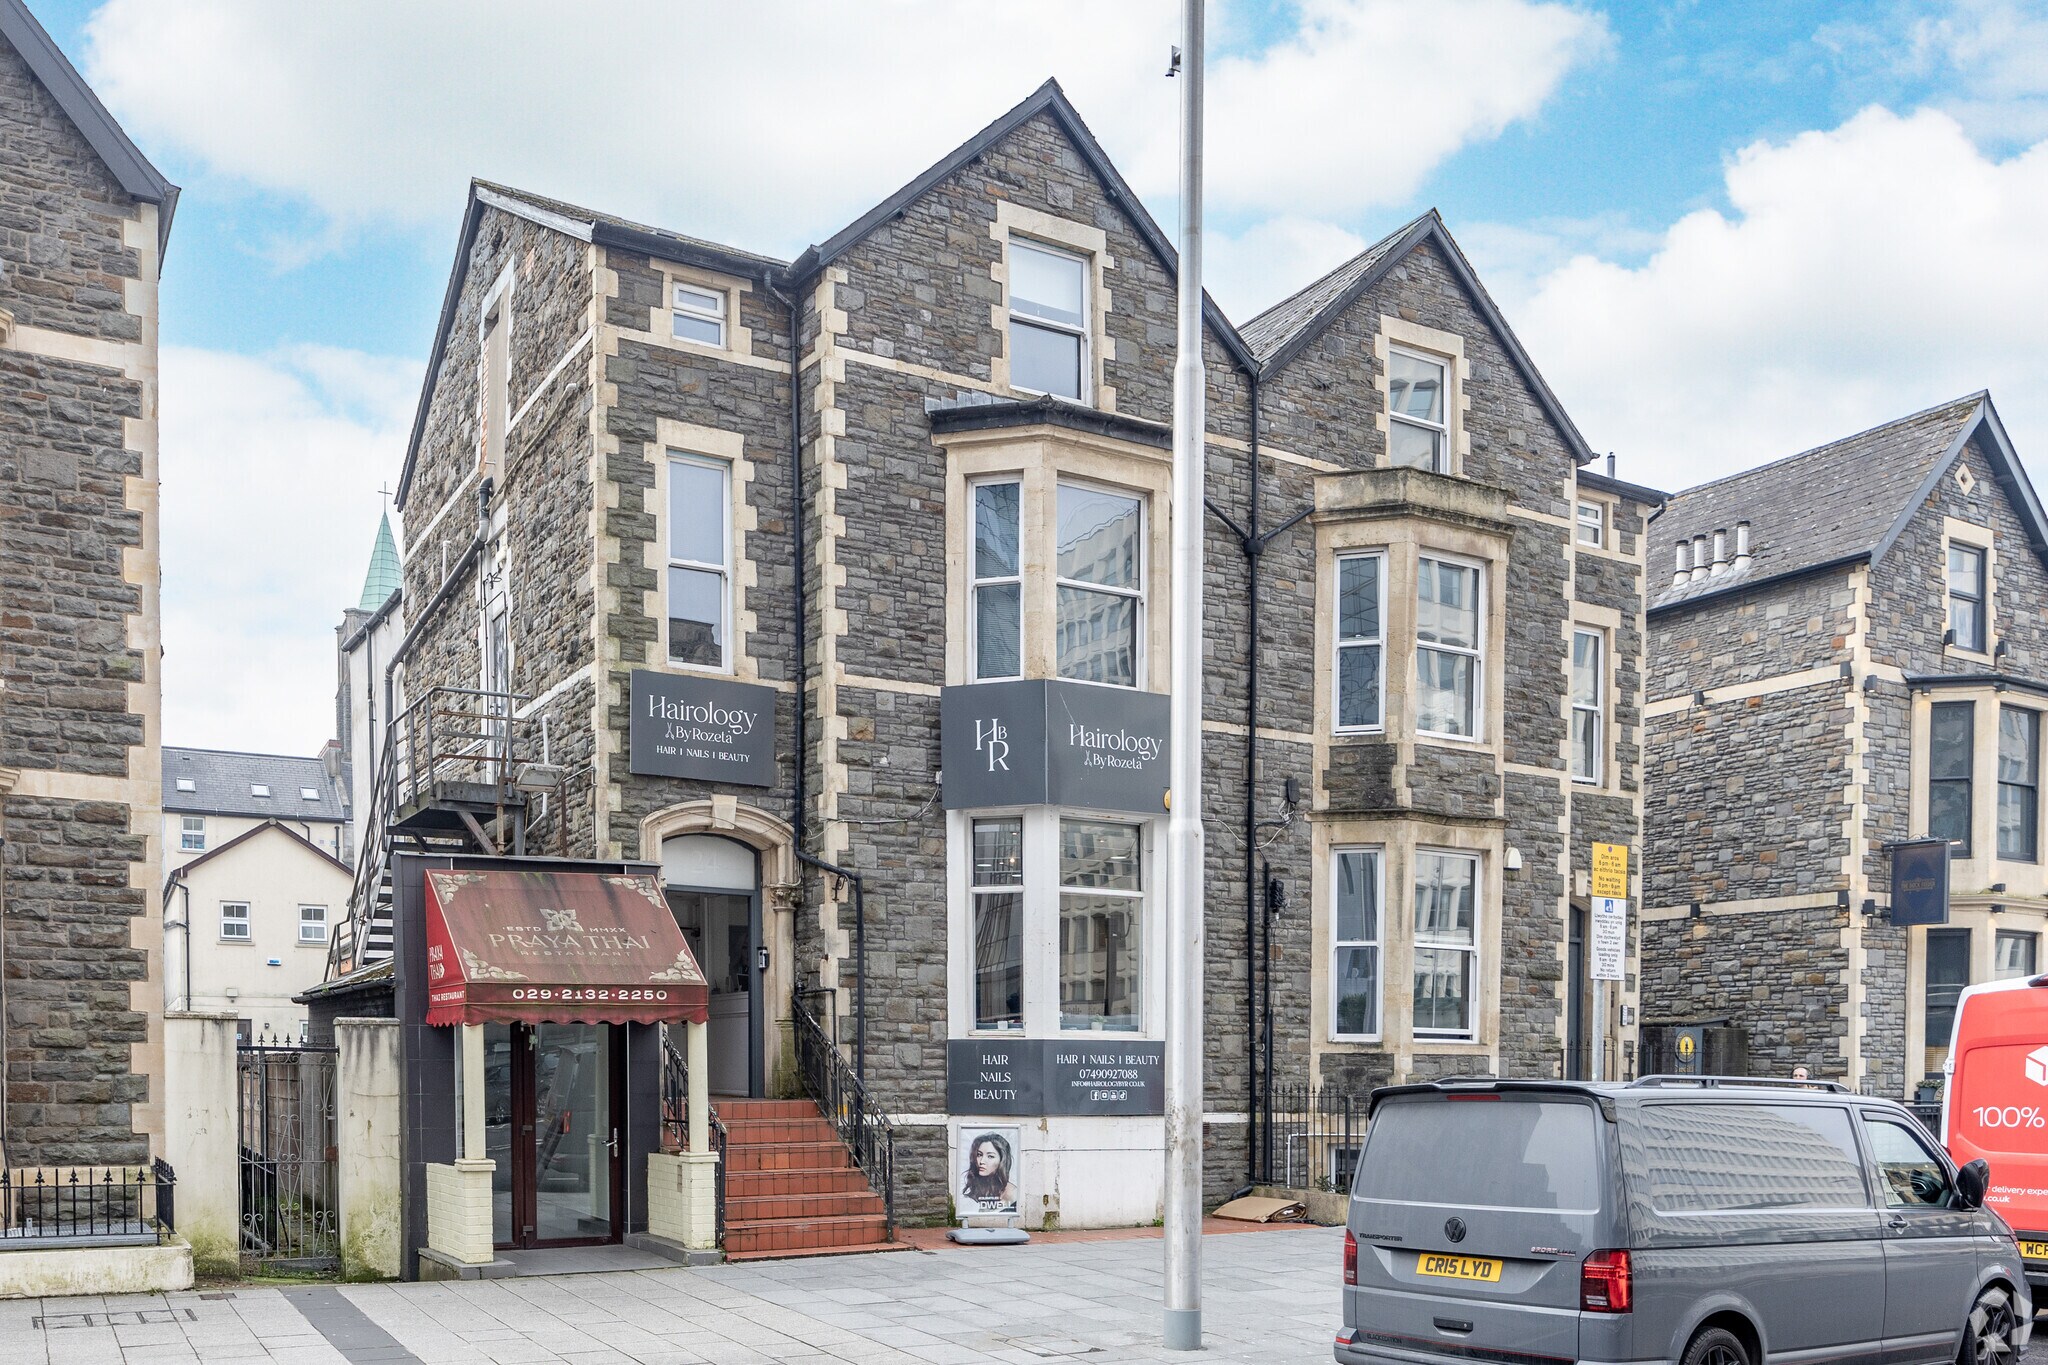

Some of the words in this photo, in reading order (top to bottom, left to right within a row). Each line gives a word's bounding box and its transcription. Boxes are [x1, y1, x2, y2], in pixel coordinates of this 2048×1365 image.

[649, 695, 757, 734] Hairology
[676, 725, 691, 742] By
[1070, 723, 1162, 760] Hairology
[656, 745, 676, 756] HAIR
[687, 748, 709, 759] NAILS
[719, 752, 750, 763] BEAUTY
[1093, 753, 1107, 769] By
[488, 933, 581, 949] PRAYA
[583, 936, 650, 949] THAI
[982, 1054, 1008, 1065] HAIR
[1056, 1054, 1078, 1064] HAIR
[1090, 1055, 1115, 1064] NAILS
[1126, 1056, 1160, 1064] BEAUTY
[980, 1072, 1011, 1082] NAILS
[1079, 1069, 1138, 1079] 07490927088
[974, 1090, 1017, 1100] BEAUTY
[1973, 1106, 2045, 1128] 100%
[1992, 1186, 2024, 1196] delivery
[1359, 1233, 1402, 1242] TRANSPORTER
[1426, 1256, 1458, 1275] CR15
[1460, 1260, 1492, 1278] LYD
